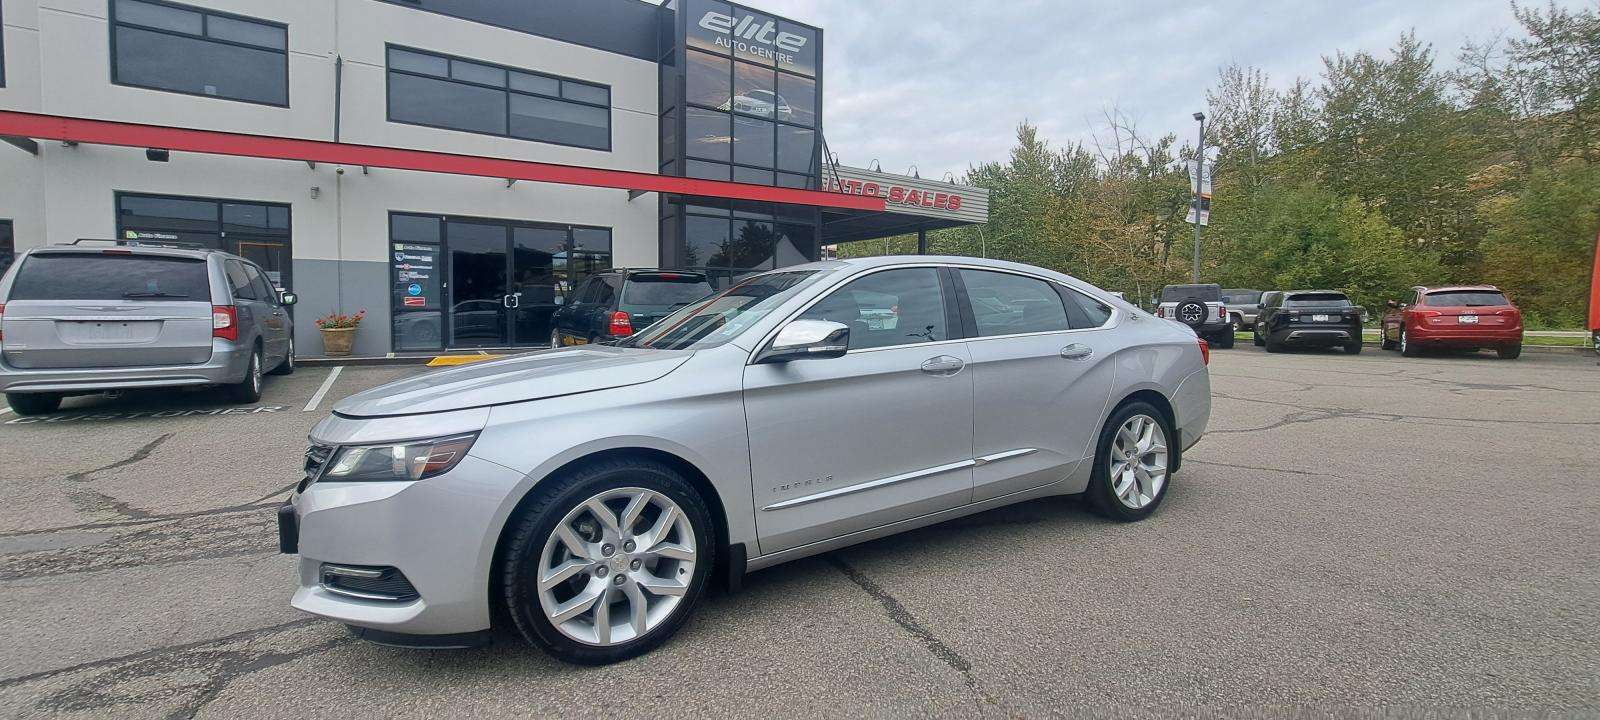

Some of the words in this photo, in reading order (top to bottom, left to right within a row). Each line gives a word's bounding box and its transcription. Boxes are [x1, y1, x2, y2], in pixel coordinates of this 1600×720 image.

[699, 11, 807, 52] elite
[715, 36, 747, 52] AUTO
[750, 45, 794, 64] CENTRE
[823, 177, 881, 196] UTO
[887, 185, 962, 211] SALES
